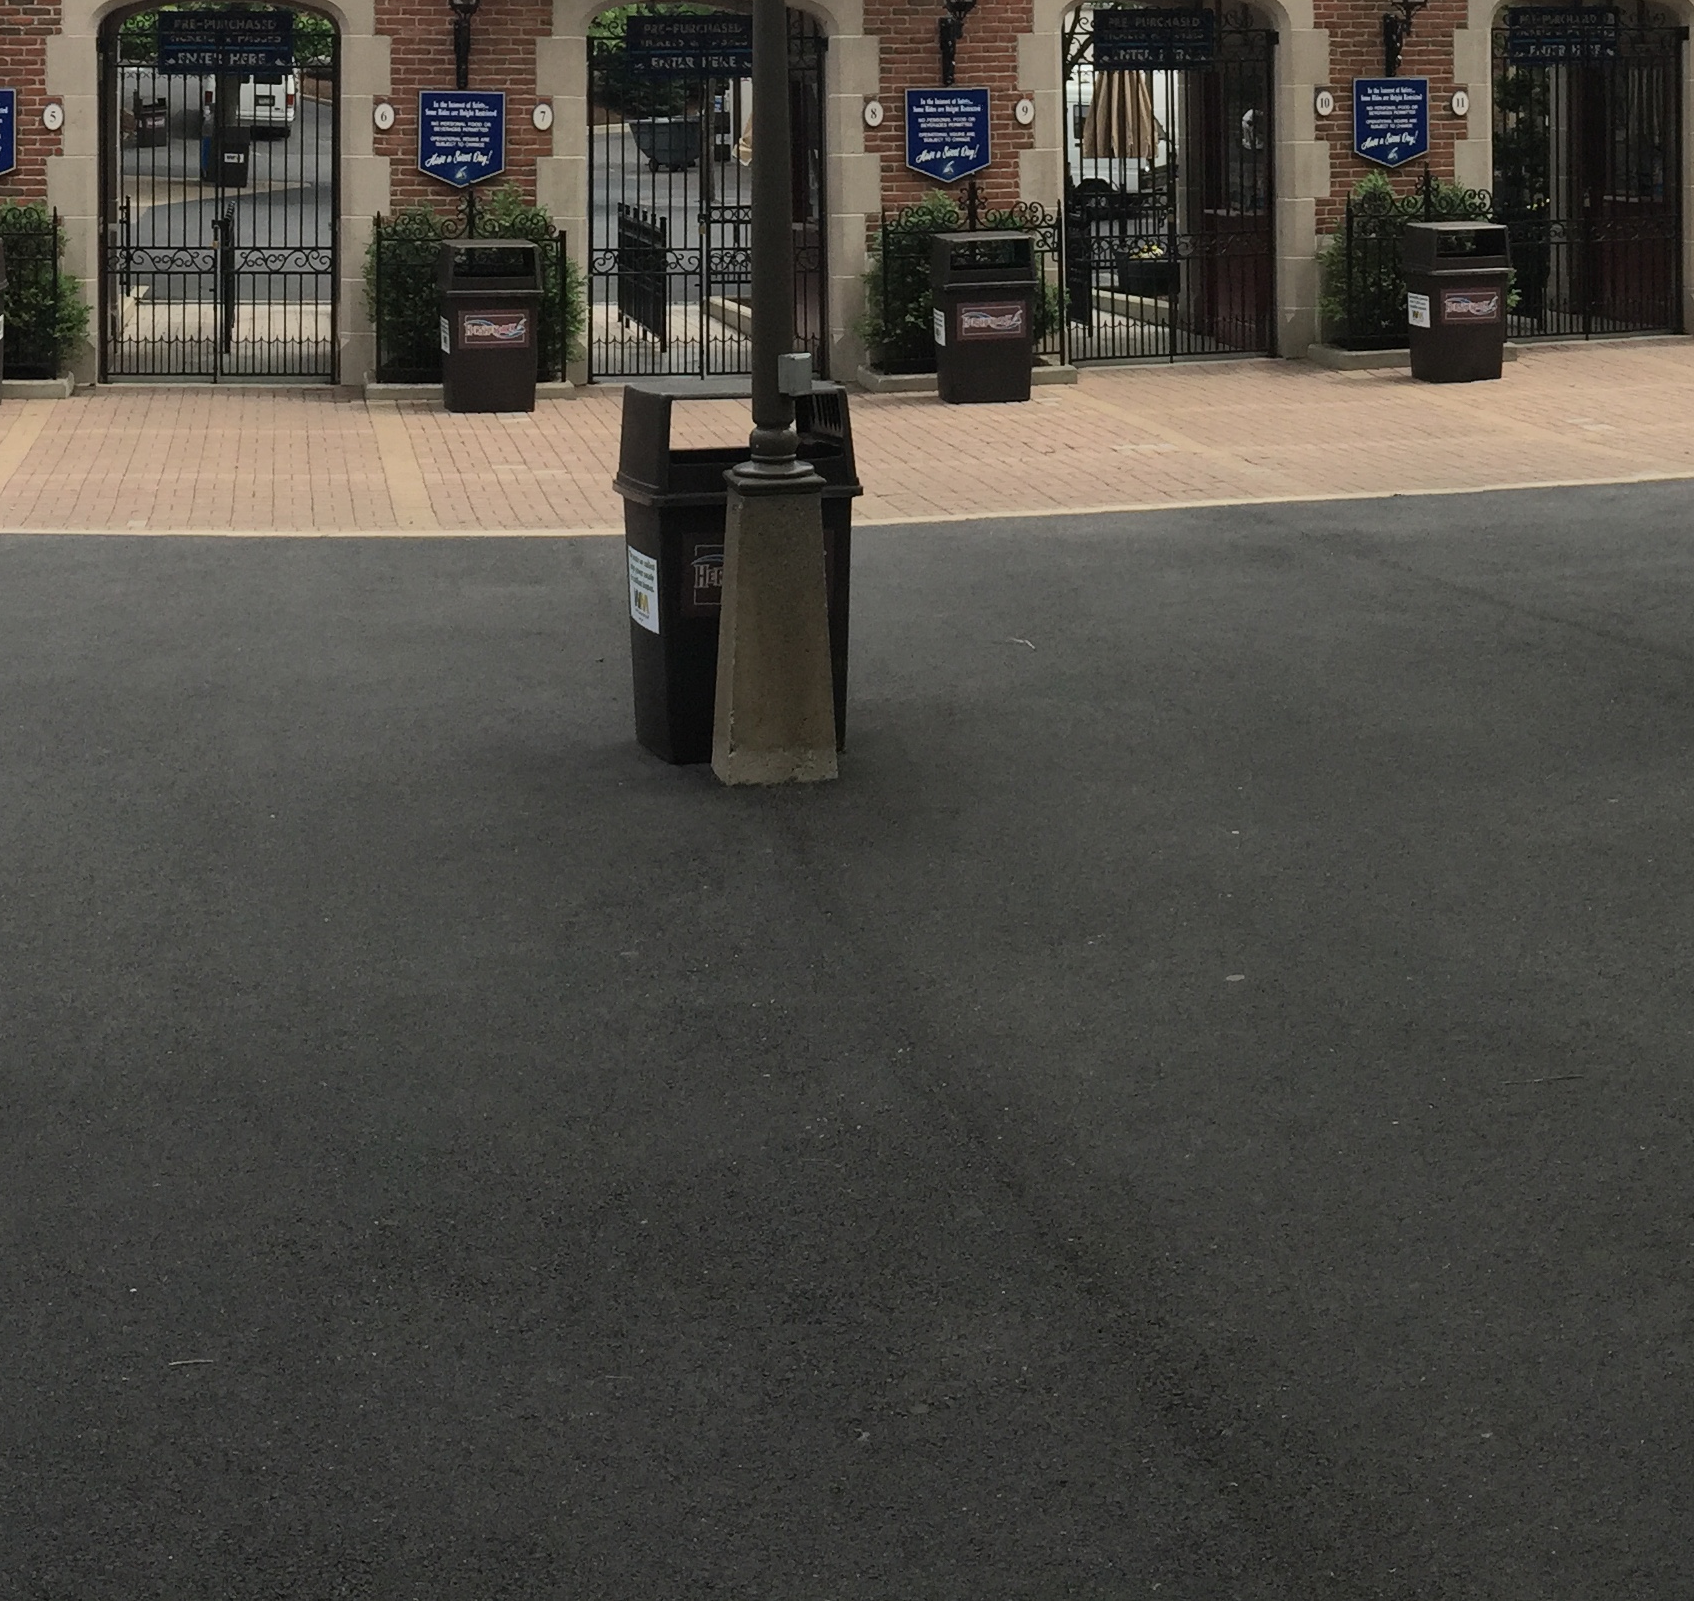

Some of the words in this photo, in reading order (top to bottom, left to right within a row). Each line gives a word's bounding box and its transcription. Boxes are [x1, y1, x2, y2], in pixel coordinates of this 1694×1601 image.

[1320, 98, 1330, 109] 10
[1456, 97, 1465, 108] 11
[49, 110, 57, 123] 5
[380, 110, 387, 122] 6
[540, 110, 546, 123] 7
[871, 108, 877, 120] 8
[1022, 105, 1029, 117] 9
